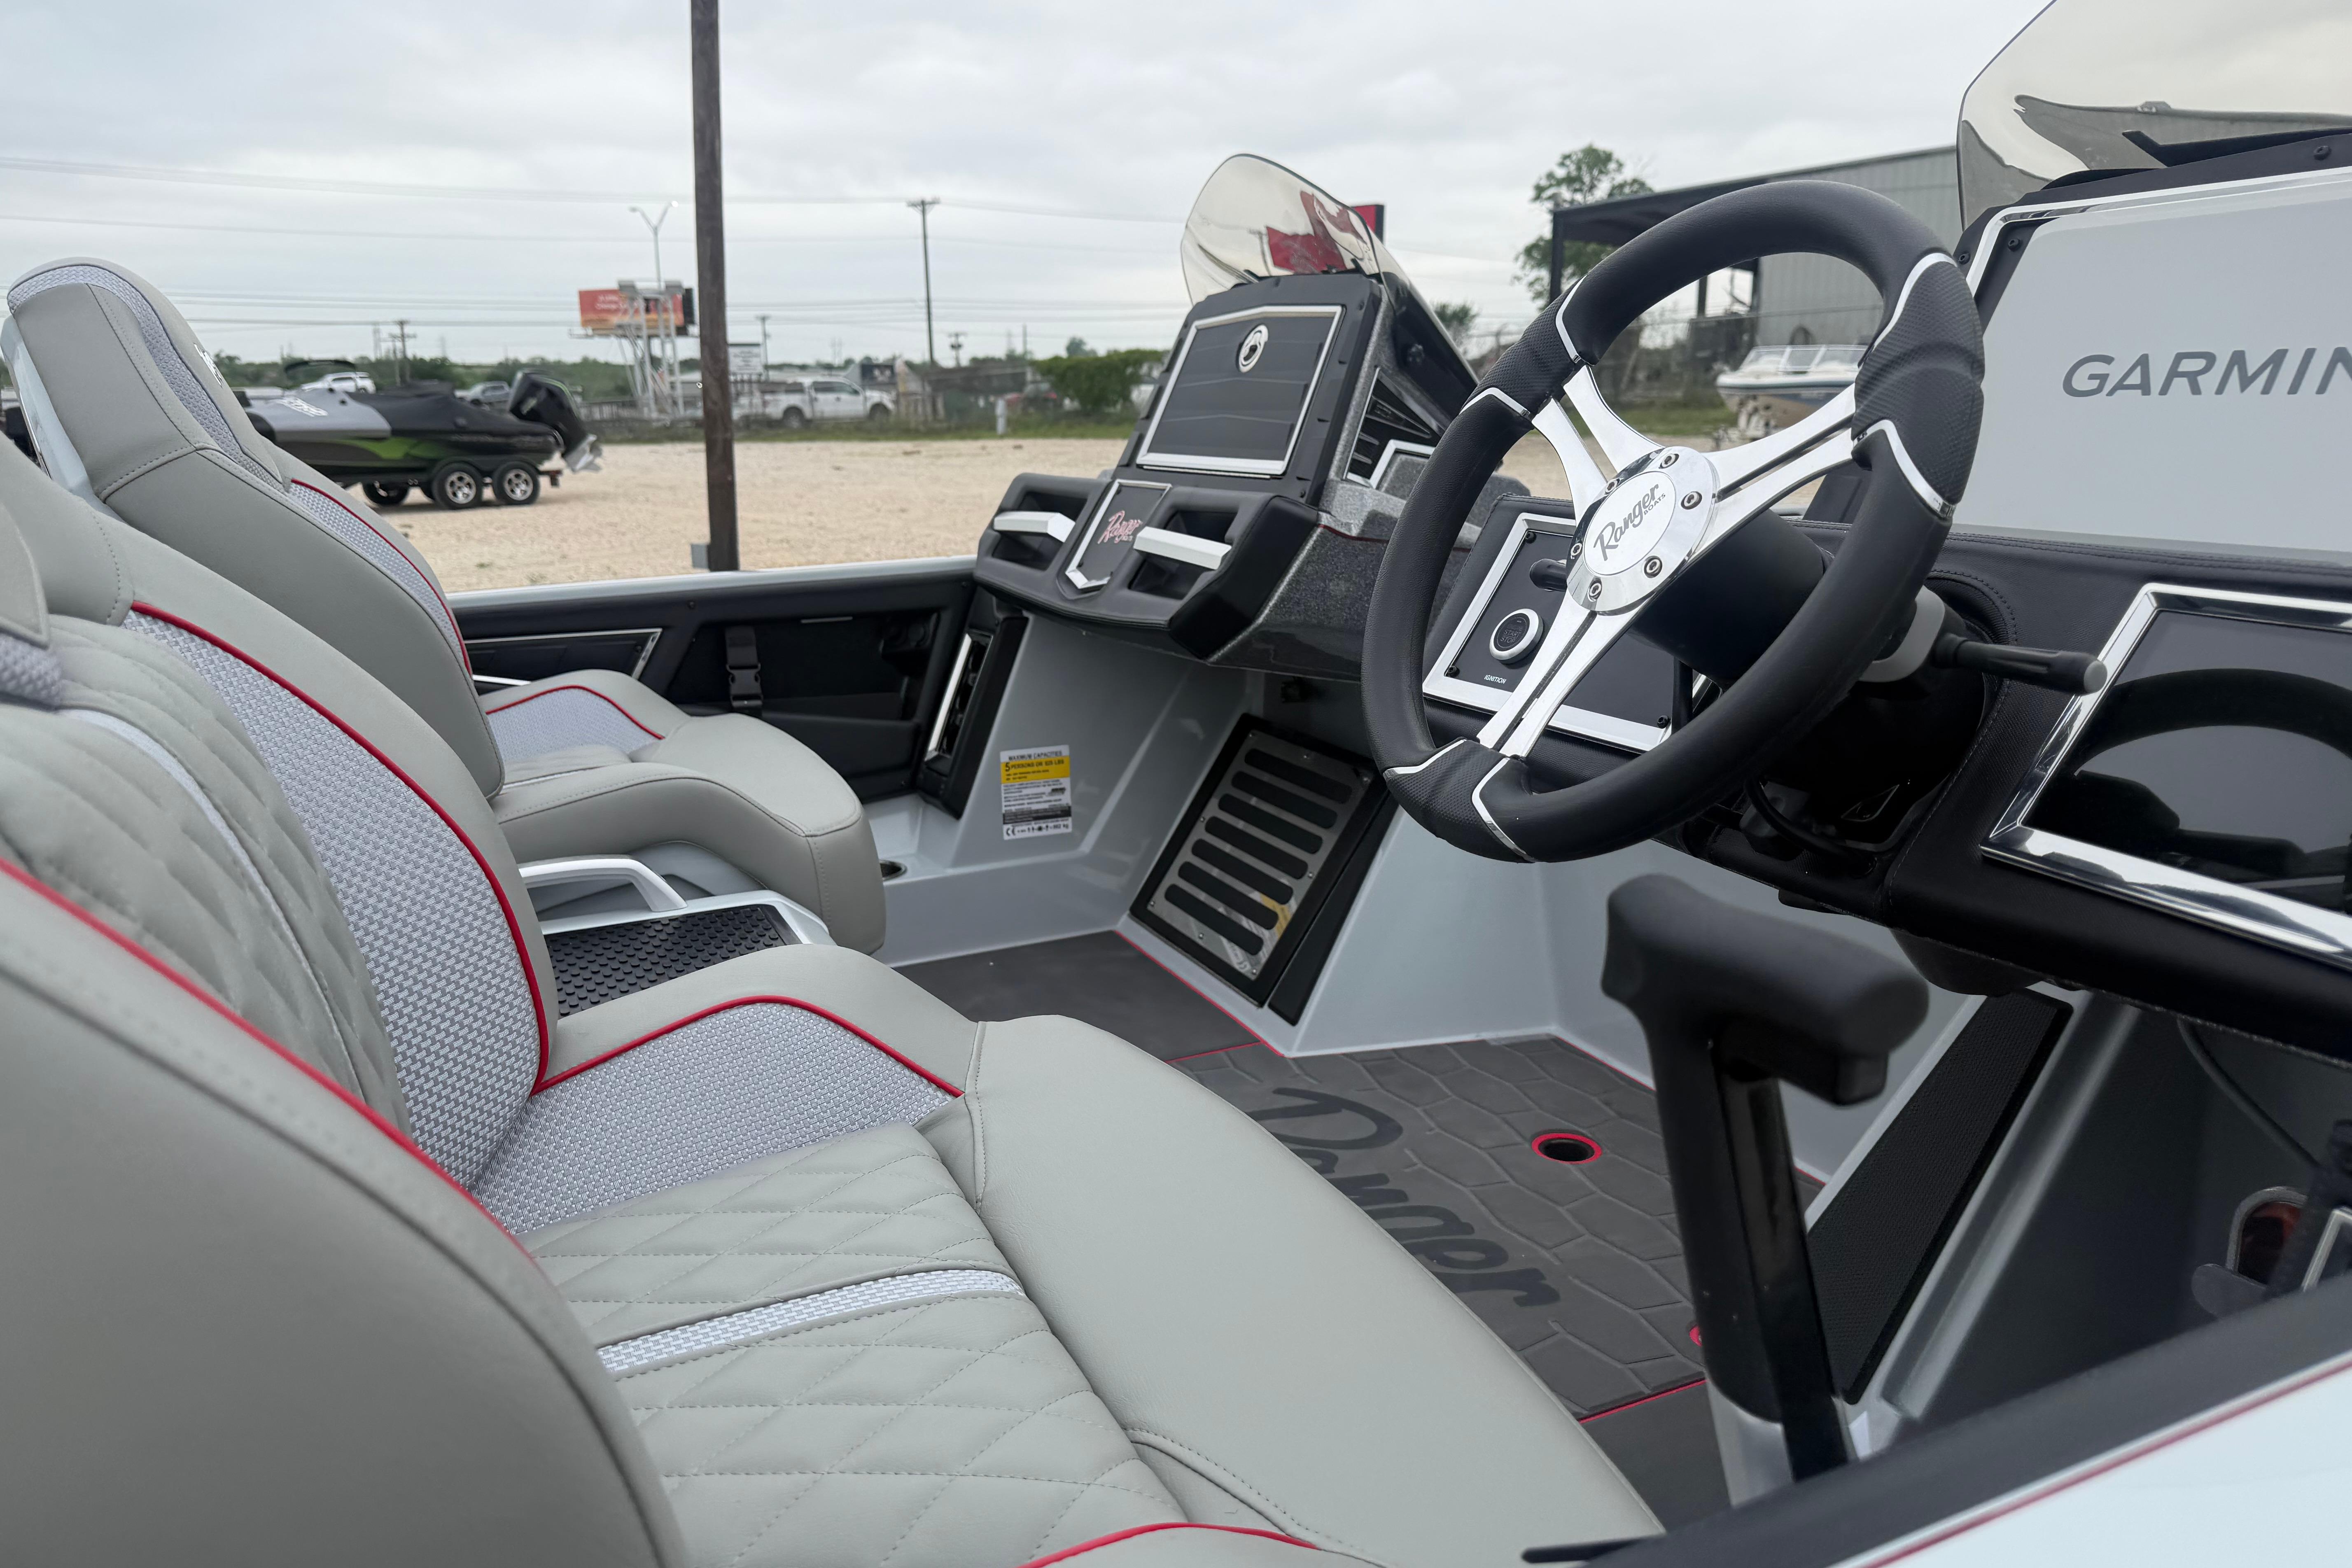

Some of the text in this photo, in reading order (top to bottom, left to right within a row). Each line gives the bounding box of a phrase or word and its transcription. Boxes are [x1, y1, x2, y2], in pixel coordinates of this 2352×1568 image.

[1643, 493, 1666, 515] BOATS
[1593, 484, 1659, 561] Ranger
[1504, 629, 1521, 637] START
[1484, 674, 1507, 684] IGNITION
[1005, 762, 1010, 772] 5
